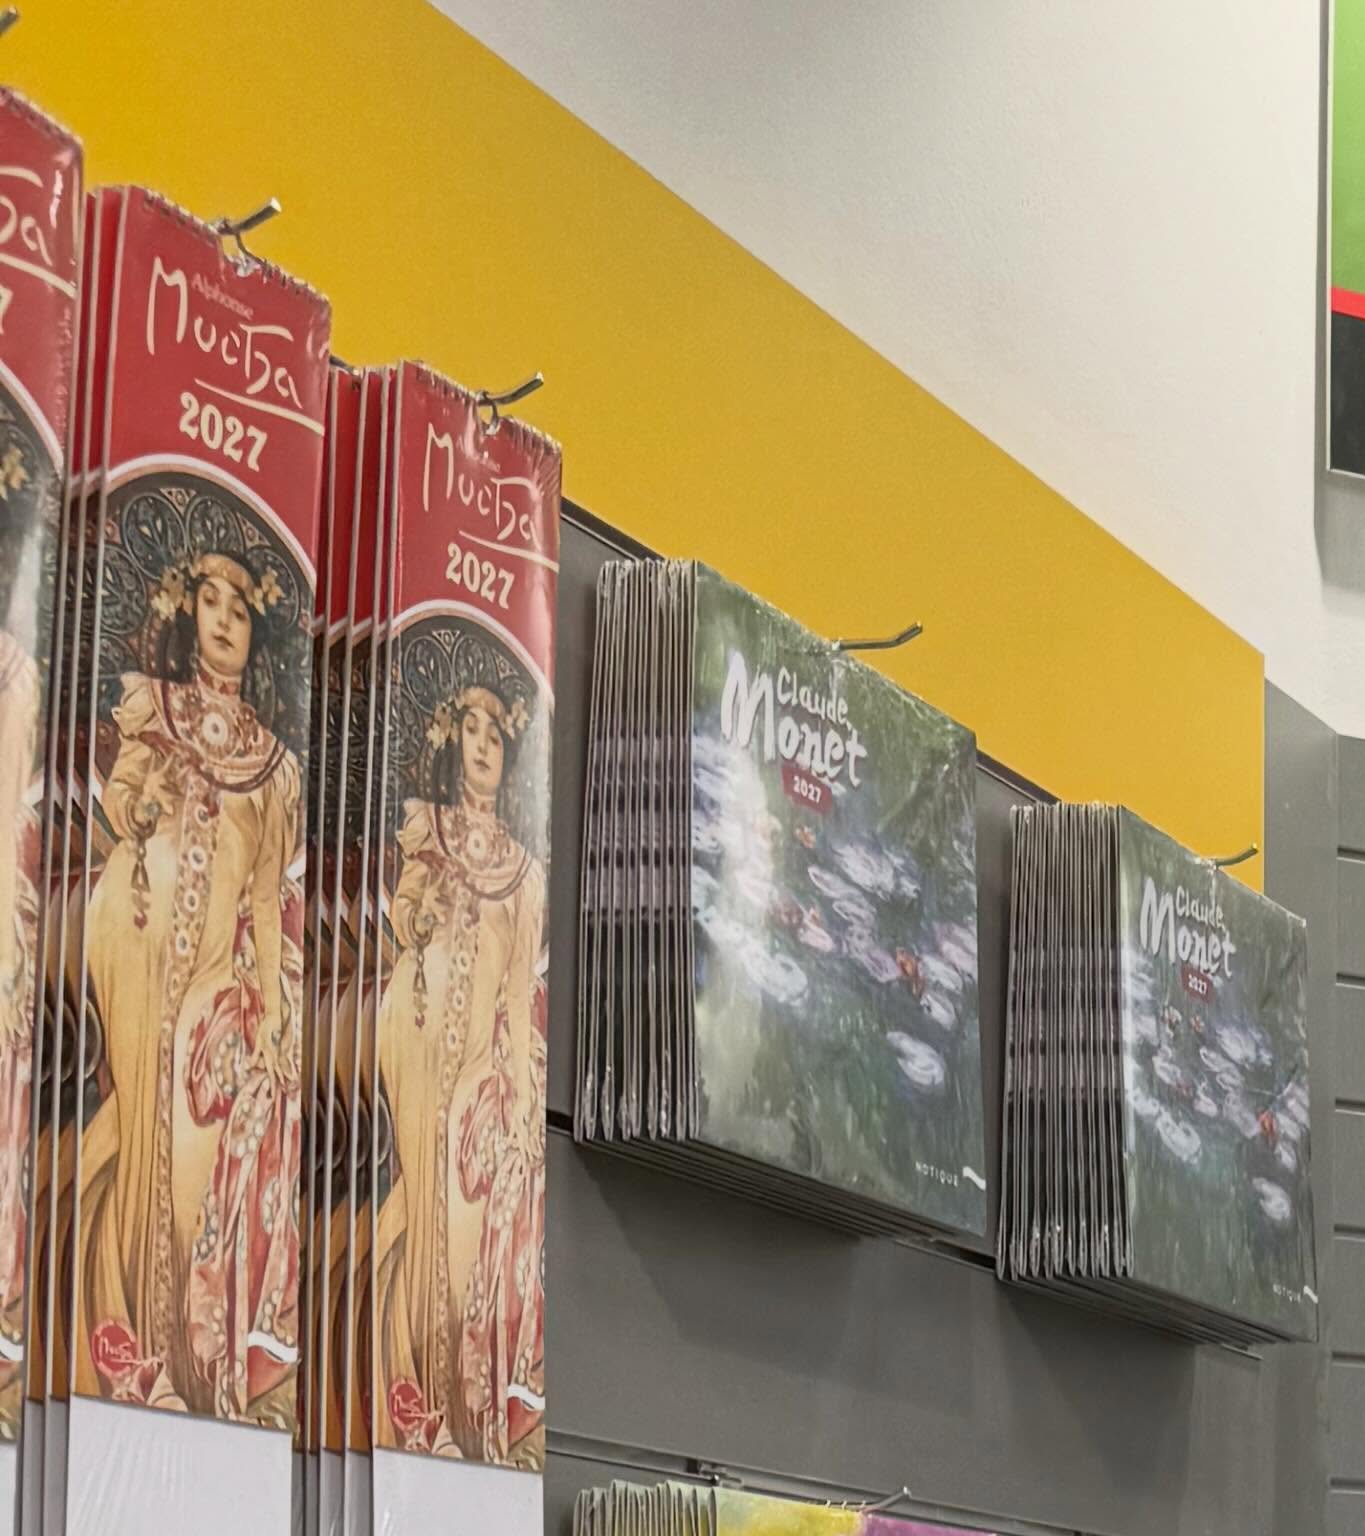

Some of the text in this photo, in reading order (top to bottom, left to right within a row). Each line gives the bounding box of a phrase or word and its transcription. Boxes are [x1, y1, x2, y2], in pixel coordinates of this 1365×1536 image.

[179, 392, 267, 472] 2027
[446, 543, 515, 609] 2027
[721, 652, 868, 787] Monet
[776, 666, 849, 725] Claude
[793, 775, 822, 803] 2027
[1140, 876, 1236, 978] Monet
[1176, 885, 1224, 929] Claude
